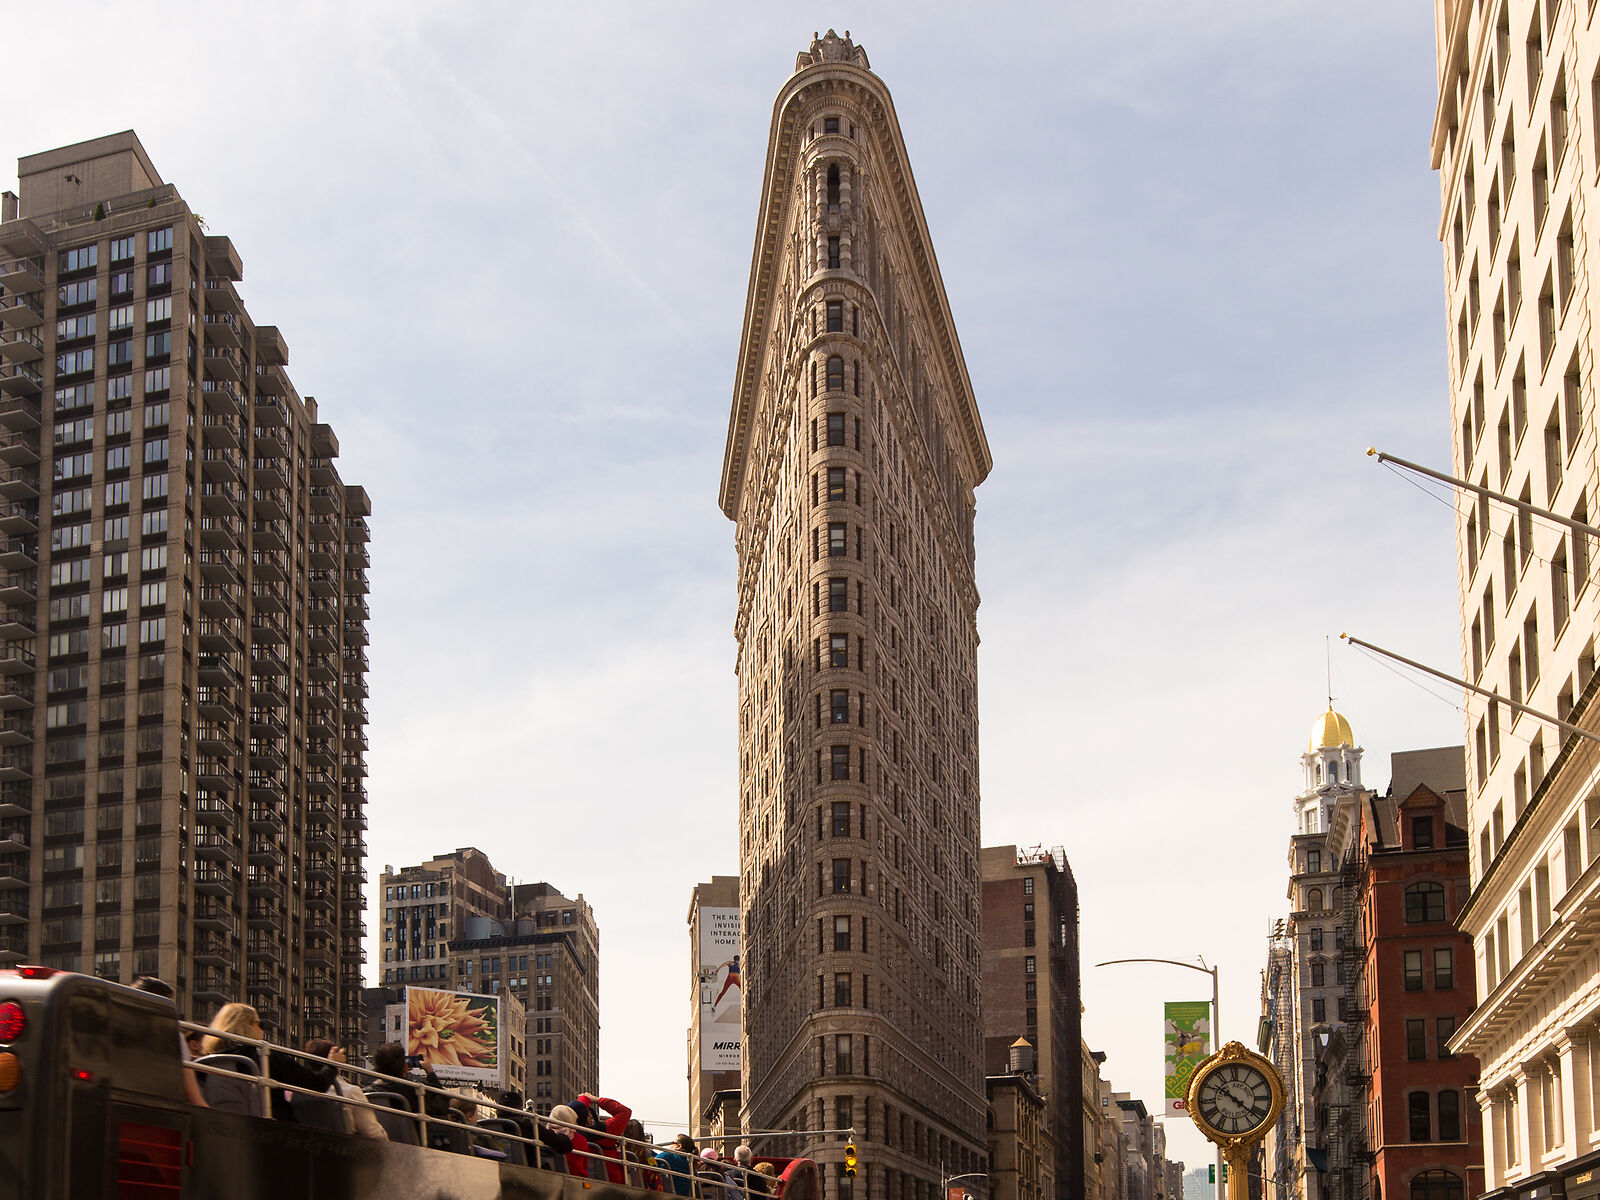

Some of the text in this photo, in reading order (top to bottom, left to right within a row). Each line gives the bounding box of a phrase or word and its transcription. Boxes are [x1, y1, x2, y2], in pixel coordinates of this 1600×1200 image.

[1166, 1066, 1191, 1088] MAD.
[1232, 1083, 1253, 1098] AVENUE
[1221, 1107, 1248, 1117] BUILDIN
